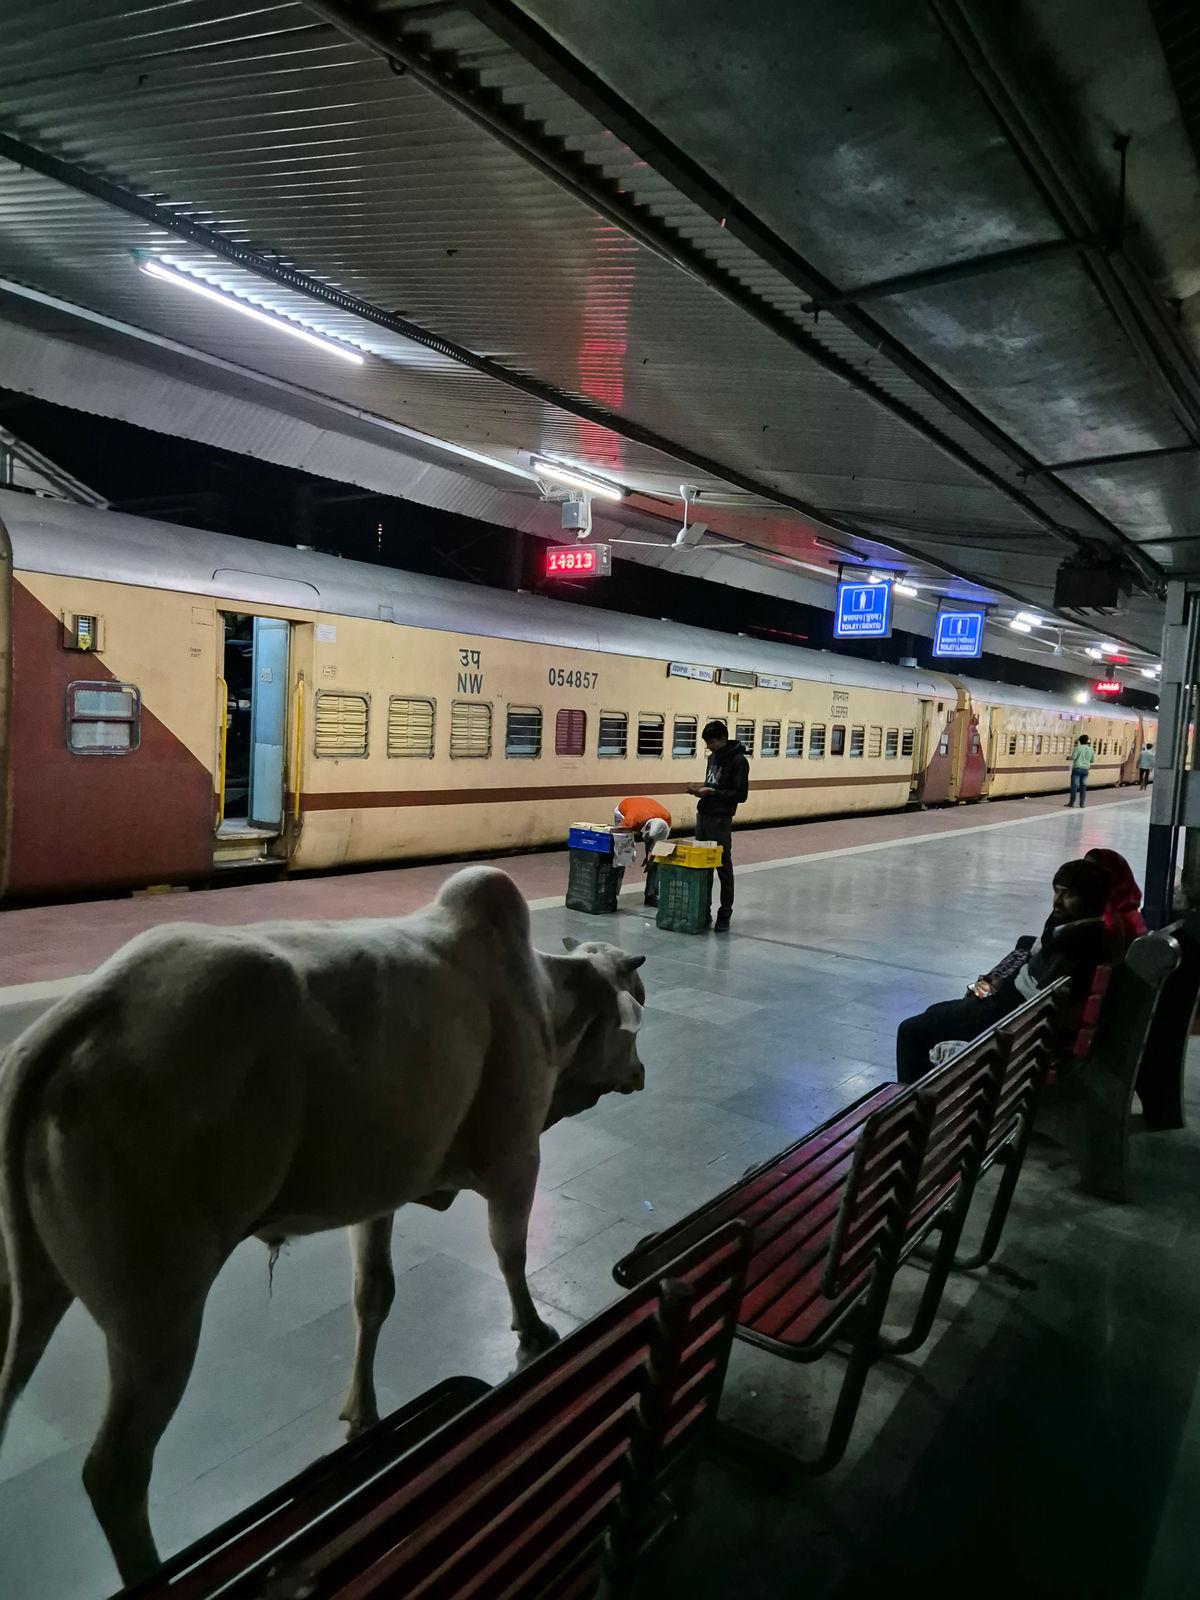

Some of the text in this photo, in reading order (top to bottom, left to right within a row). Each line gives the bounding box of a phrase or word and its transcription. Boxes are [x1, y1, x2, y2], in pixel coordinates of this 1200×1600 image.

[549, 553, 592, 570] 14813
[842, 623, 858, 631] TOILET
[459, 648, 481, 670] उप
[457, 672, 484, 694] NW
[548, 667, 599, 690] 054857
